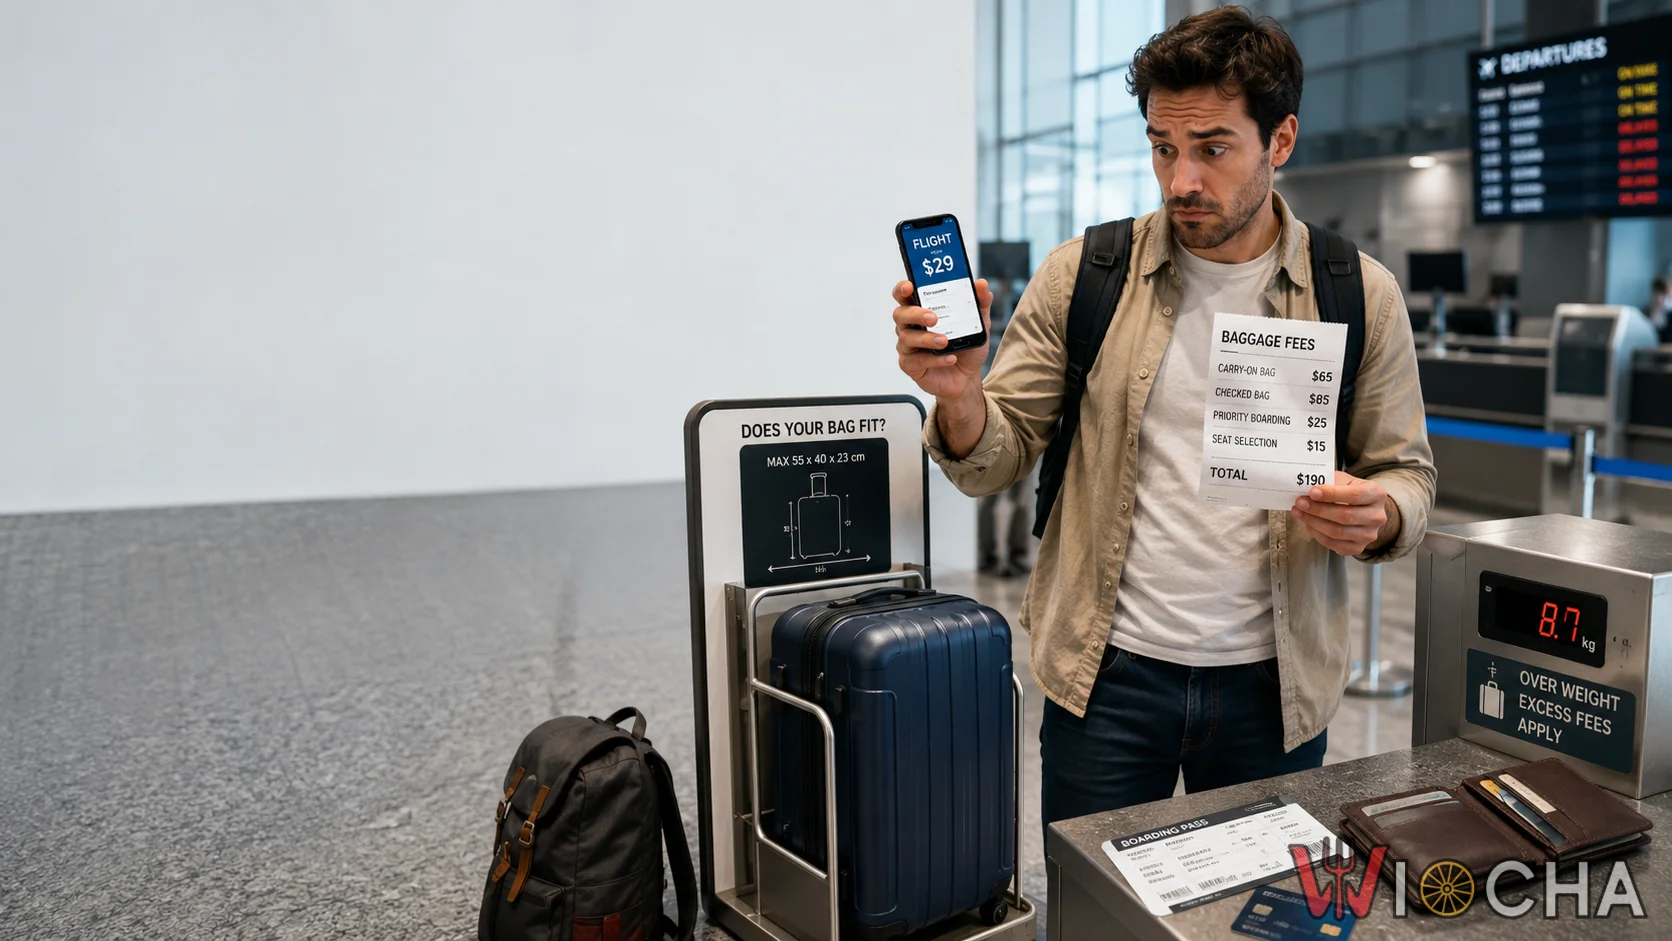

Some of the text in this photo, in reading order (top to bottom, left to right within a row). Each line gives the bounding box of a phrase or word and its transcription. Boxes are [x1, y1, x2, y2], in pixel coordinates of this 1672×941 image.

[1501, 36, 1607, 75] DEPARTURES
[912, 233, 952, 250] FLIGHT
[922, 255, 954, 277] $29
[1221, 330, 1315, 350] BAGGAGE FEES
[1218, 363, 1276, 377] CARRY-ON BAG
[1311, 370, 1333, 382] $65
[1215, 387, 1270, 401] CHECKED BAG
[1308, 393, 1330, 406] $85
[1213, 410, 1291, 426] PRIORITY BOARDING
[1307, 416, 1327, 429] $25
[741, 418, 886, 439] DOES YOUR BAG FIT?
[1212, 434, 1278, 448] SEAT SELECTION
[1306, 440, 1326, 452] $15
[767, 456, 790, 467] MAX
[792, 455, 804, 466] 55
[806, 457, 813, 465] x
[814, 454, 827, 464] 40
[837, 452, 849, 463] 23
[851, 453, 866, 462] cm
[1210, 467, 1248, 481] TOTAL
[1296, 472, 1326, 487] $190
[1538, 601, 1596, 653] 8.7 kg
[1519, 670, 1620, 712] OVER WEIGHT
[1519, 693, 1612, 735] EXCESS FEES
[1518, 717, 1563, 744] APPLY
[1120, 826, 1180, 848] BOARDING
[1180, 818, 1209, 832] PASS
